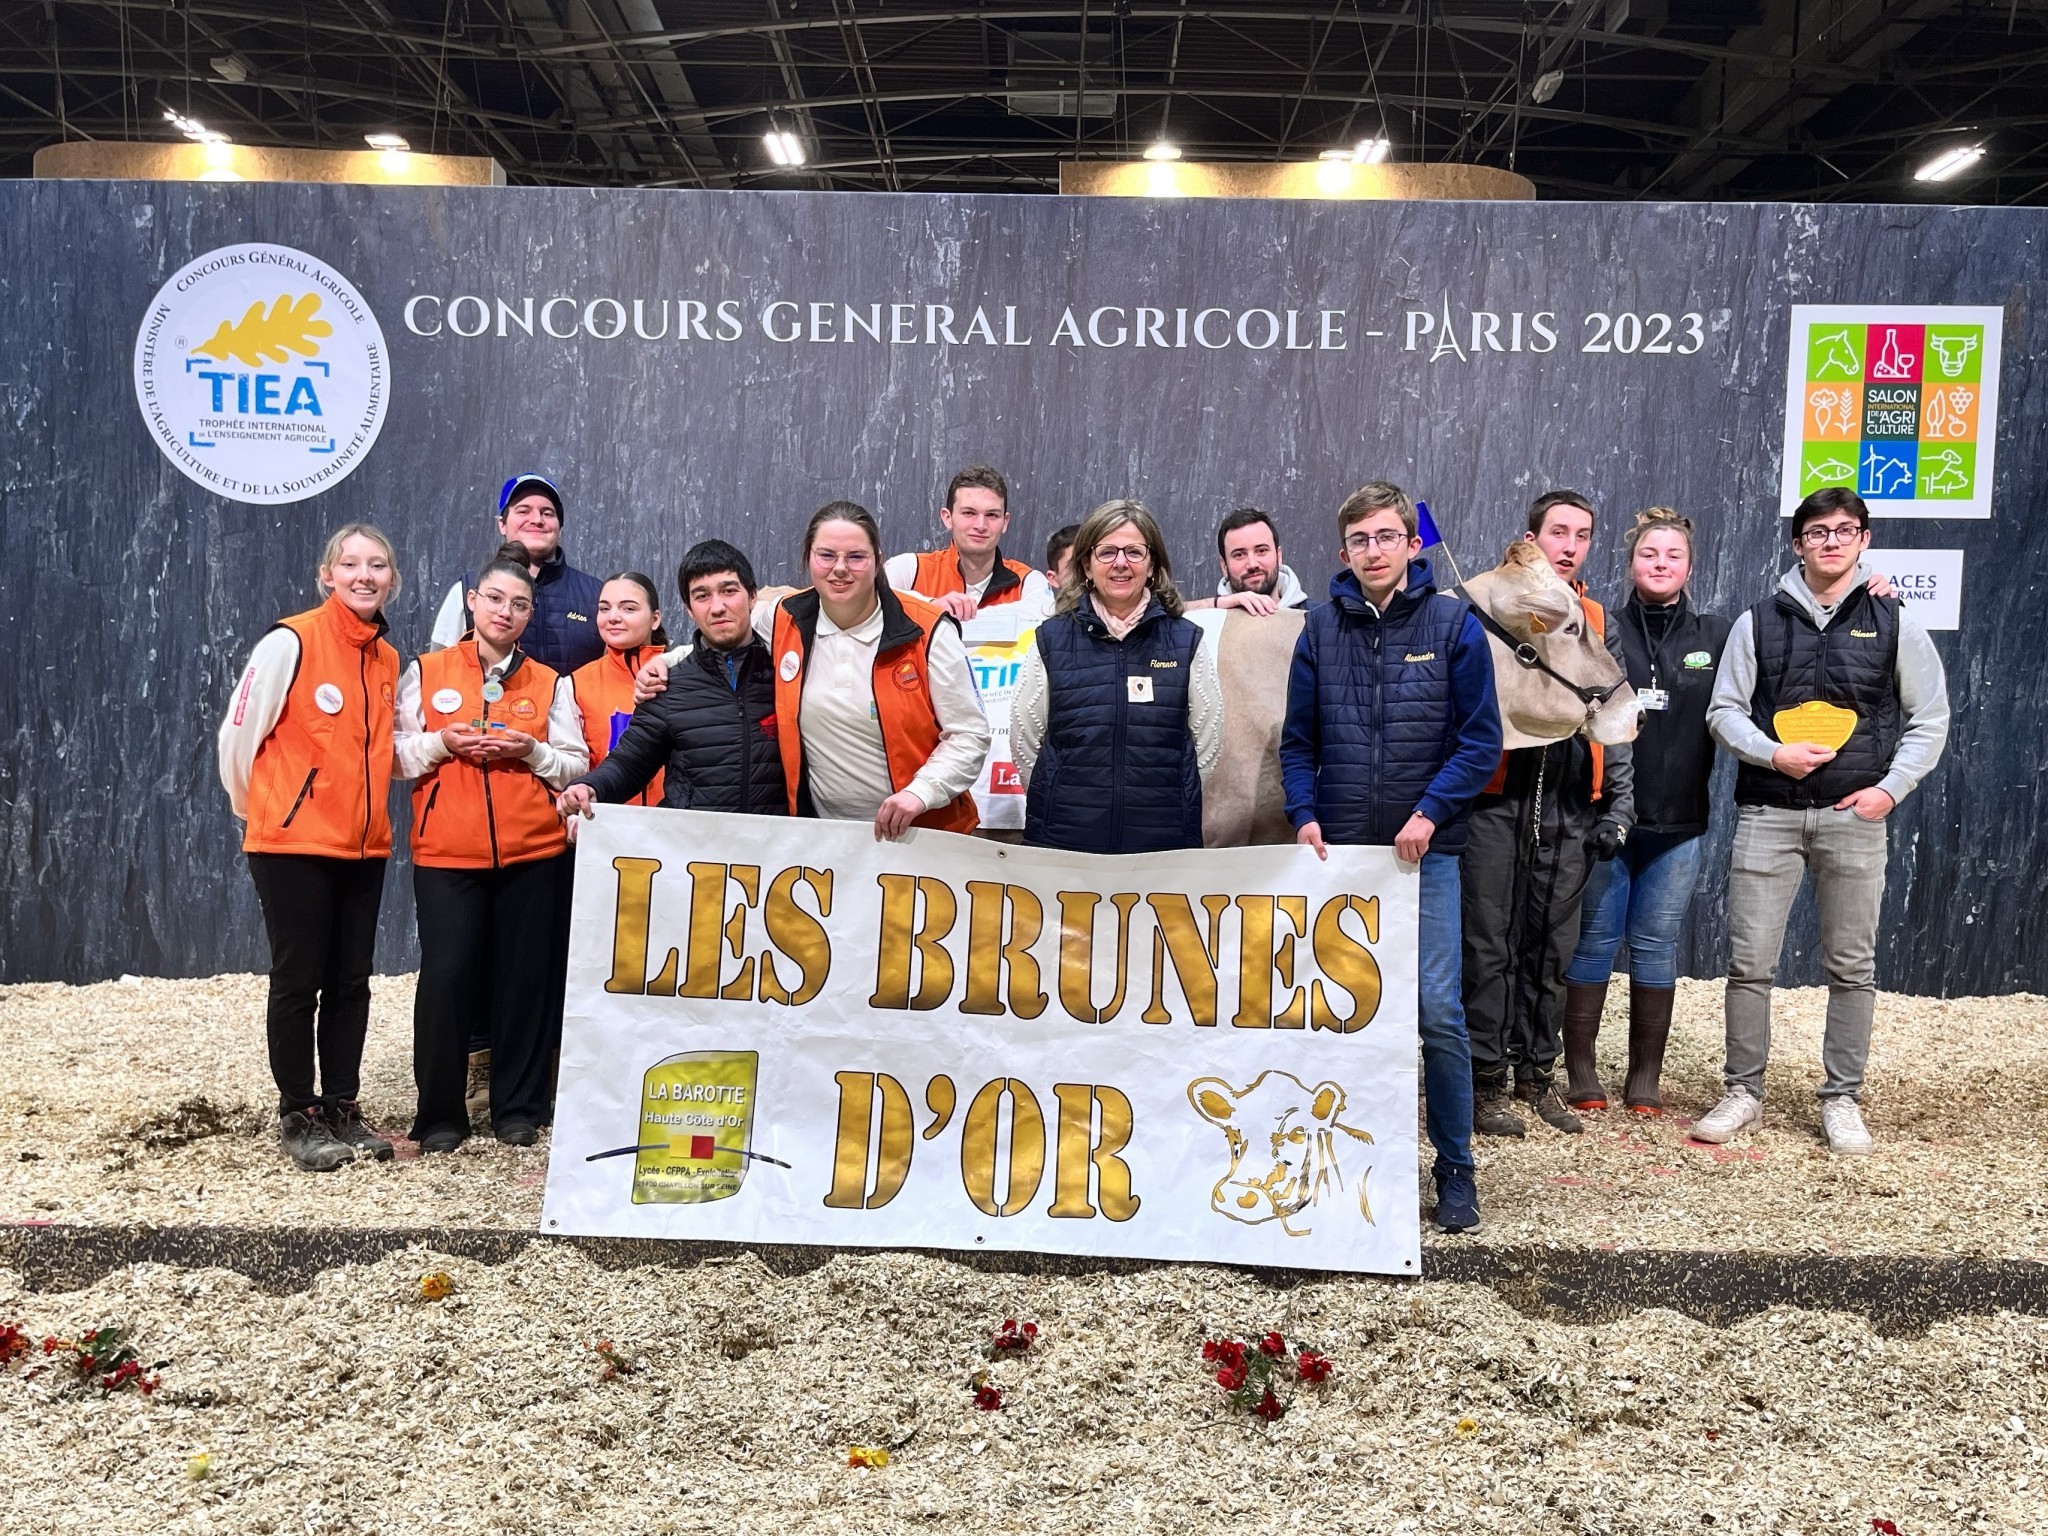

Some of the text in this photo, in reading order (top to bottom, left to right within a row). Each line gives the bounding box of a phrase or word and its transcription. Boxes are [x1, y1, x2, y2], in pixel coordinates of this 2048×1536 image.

[176, 250, 366, 325] CONCOURS GÉNÉRAL AGRICOLE
[403, 295, 744, 342] CONCOURS
[762, 301, 1033, 347] GENERAL
[1048, 305, 1348, 351] AGRICOLE
[1404, 288, 1558, 363] PARIS
[1581, 311, 1706, 355] 2023
[142, 303, 383, 496] MINISTÈRE DE L'AGRICULTURE ET DE LA SOUVERAINETÉ ALIMENTAIRE
[198, 371, 323, 417] TIEA
[1868, 389, 1917, 404] SALON
[199, 418, 327, 433] TROPHÉE INTERNATIONAL
[1866, 424, 1915, 435] CULTURE
[207, 430, 282, 442] L'ENSEIGNEMENT
[284, 434, 327, 444] AGRICOLE
[1888, 574, 1937, 589] ACES
[1894, 590, 1936, 600] RANCE
[1150, 659, 1178, 669] Florence
[604, 855, 1382, 1035] LES BRUNES
[648, 1082, 746, 1105] LA BAROTTE
[644, 1111, 744, 1128] Haute Côte d'Or
[822, 1070, 1141, 1223] D'OR
[638, 1164, 661, 1176] Lycée
[665, 1165, 691, 1176] CFPPA
